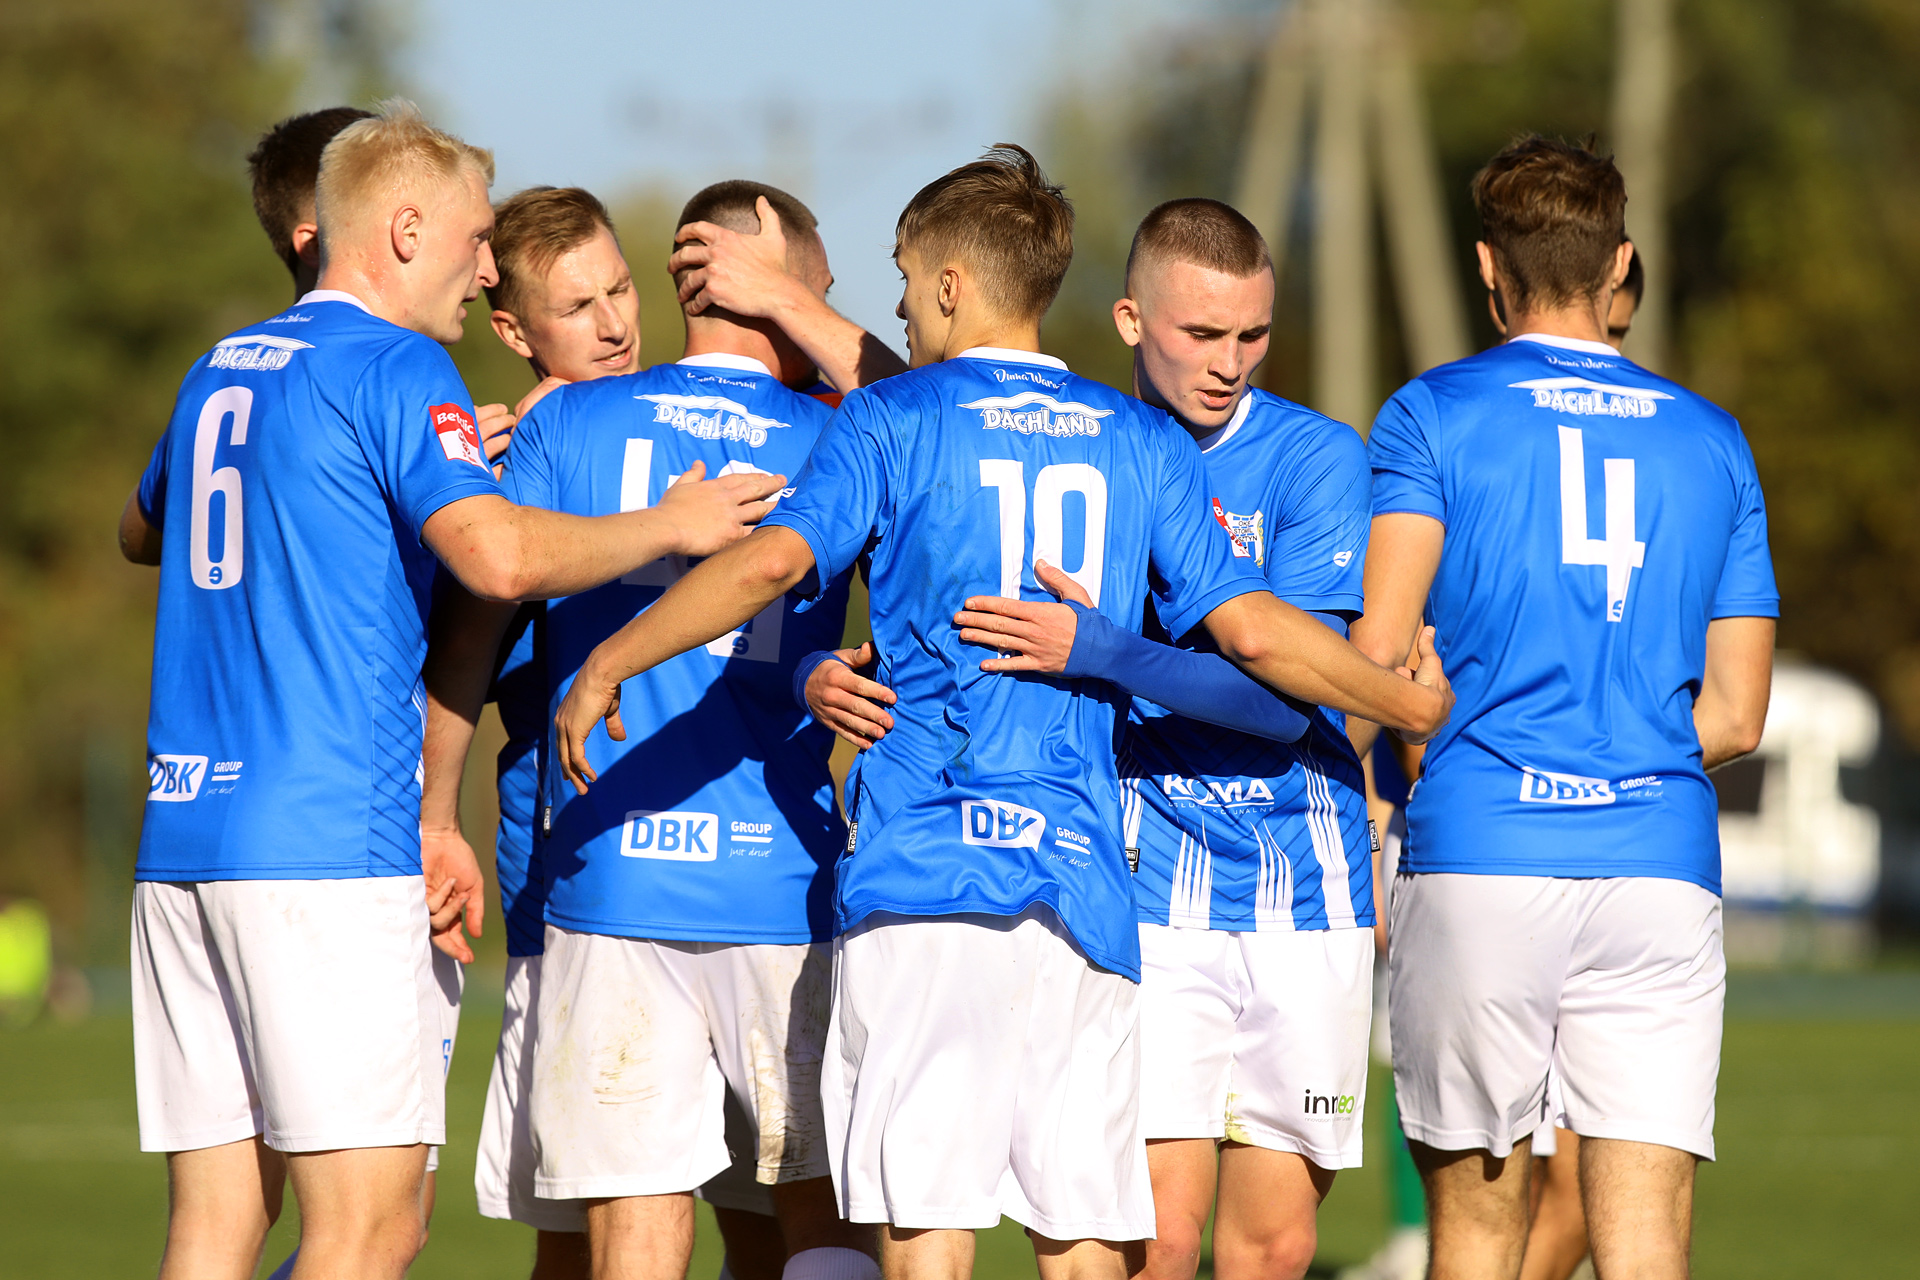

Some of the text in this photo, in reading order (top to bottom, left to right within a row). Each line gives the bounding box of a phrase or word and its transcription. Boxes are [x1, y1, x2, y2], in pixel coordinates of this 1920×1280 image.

[207, 345, 293, 371] DACHLAND
[1531, 388, 1657, 418] DACHLAND
[653, 402, 768, 448] DACHLAND
[979, 407, 1101, 437] DACHLAND
[190, 385, 254, 590] 6
[979, 459, 1108, 610] 10
[1558, 425, 1645, 622] 4
[213, 761, 243, 773] GROUP
[1163, 774, 1275, 804] KOMA
[1620, 775, 1657, 790] GROUP
[630, 816, 710, 853] DBK
[730, 821, 772, 834] GROUP
[1056, 826, 1091, 846] GROUP
